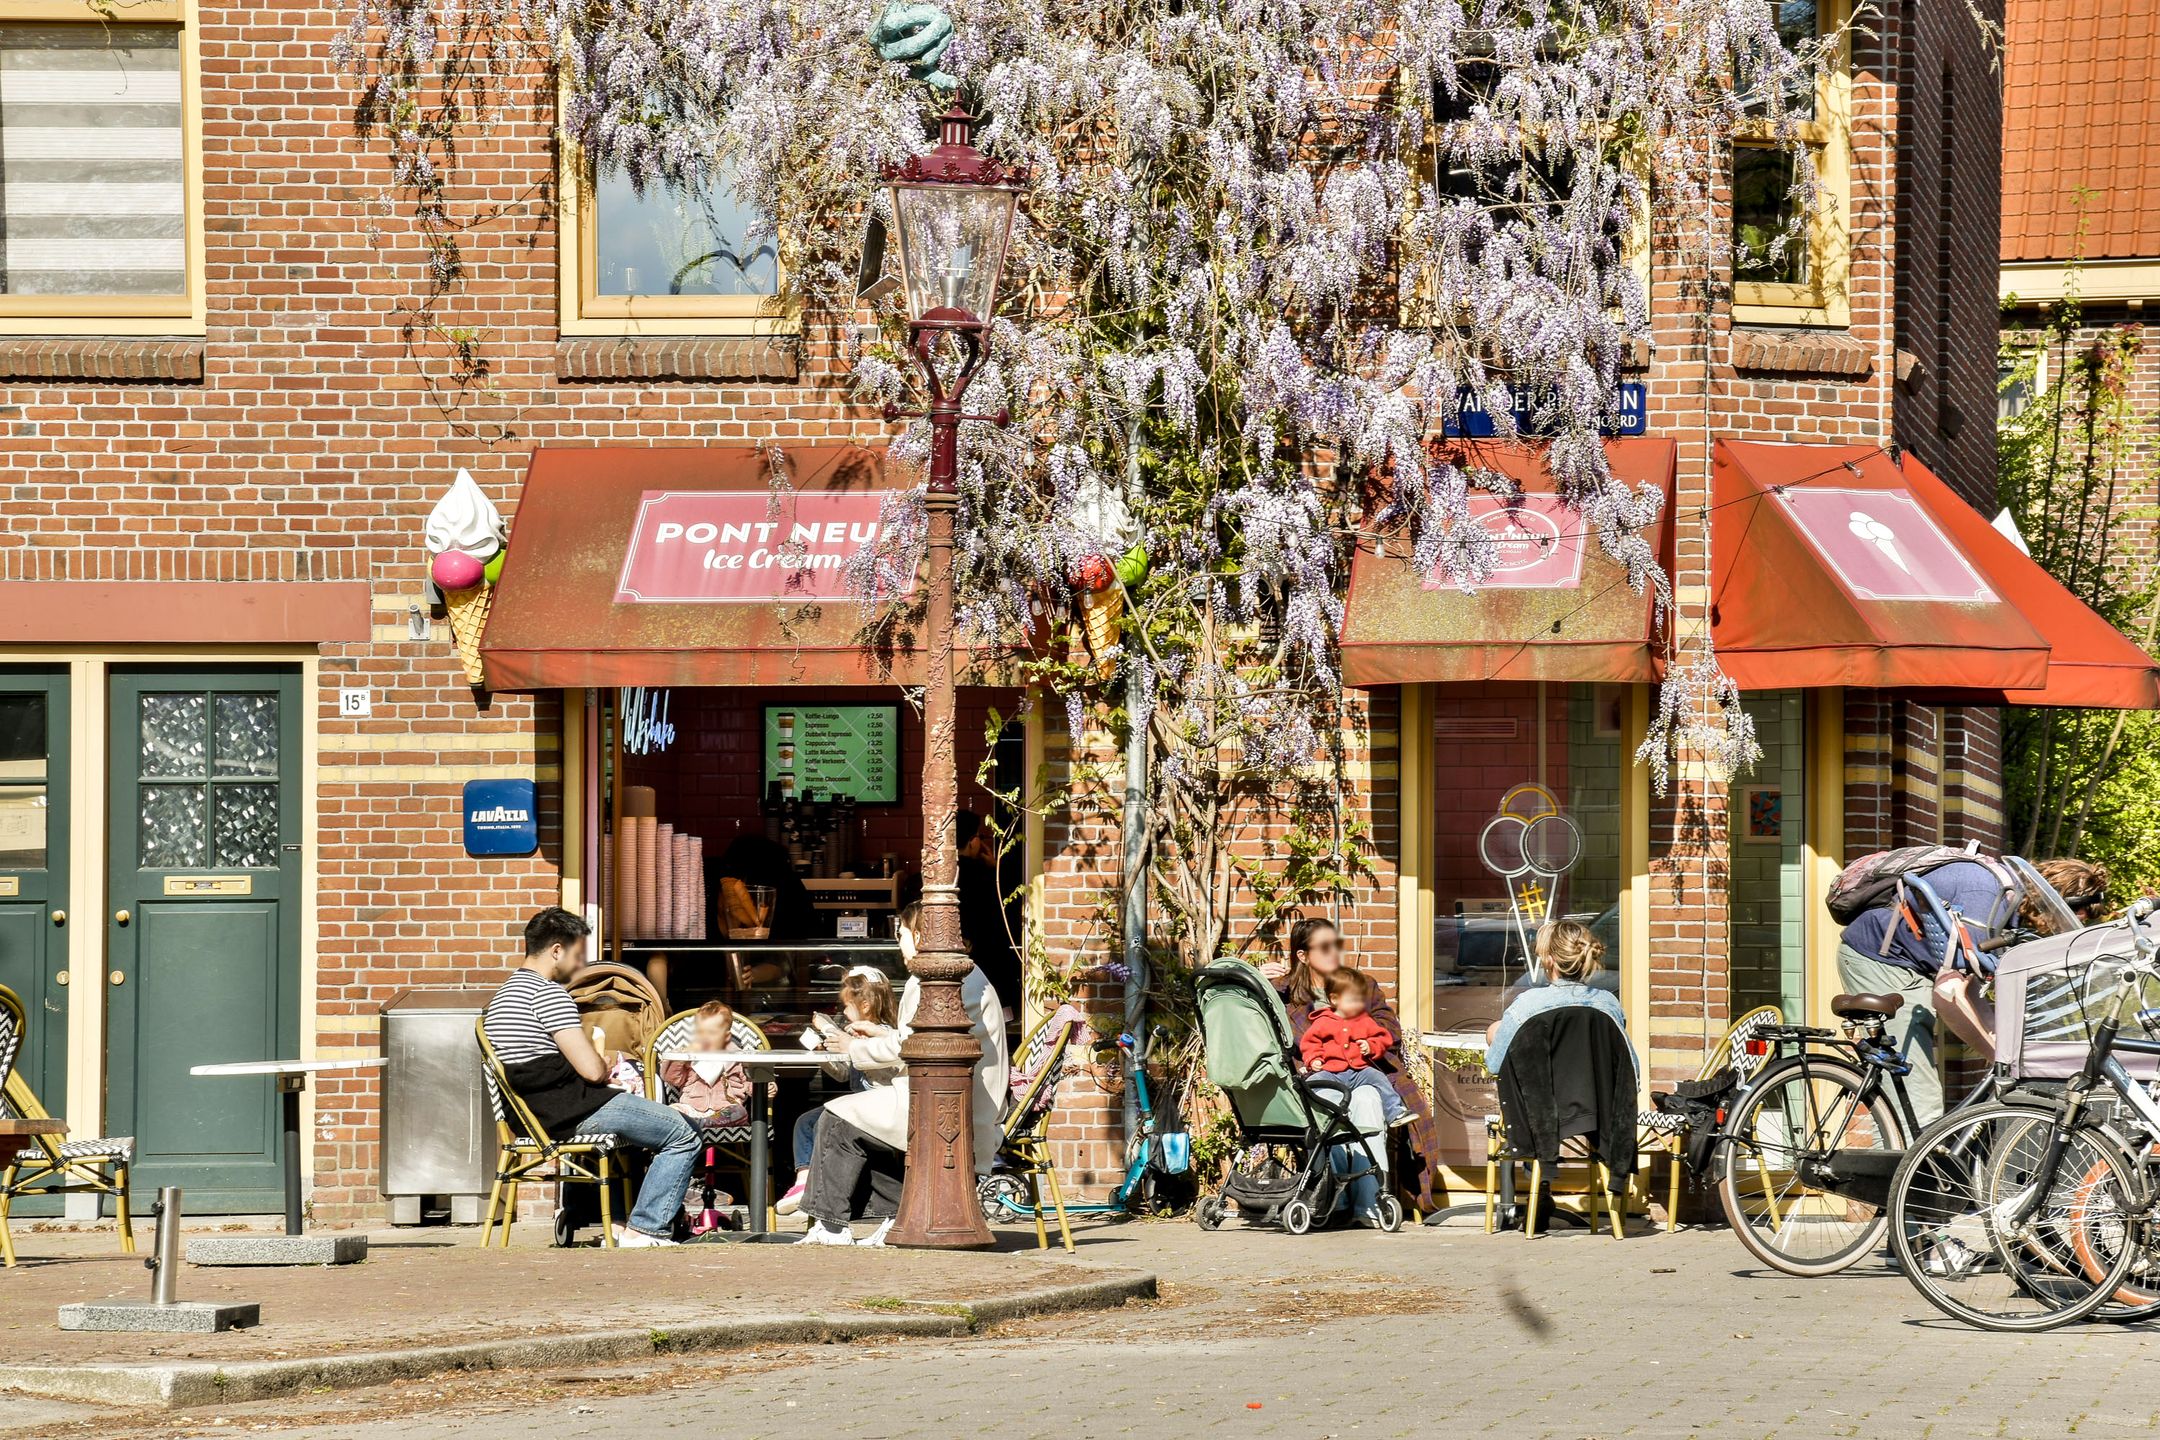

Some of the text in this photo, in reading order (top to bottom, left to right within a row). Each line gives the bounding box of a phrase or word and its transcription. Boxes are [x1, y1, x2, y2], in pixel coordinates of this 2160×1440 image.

[655, 522, 778, 544] PONT
[703, 548, 841, 569] Ice Cream
[471, 806, 529, 823] LAVAZZA
[1457, 1073, 1470, 1085] Ice
